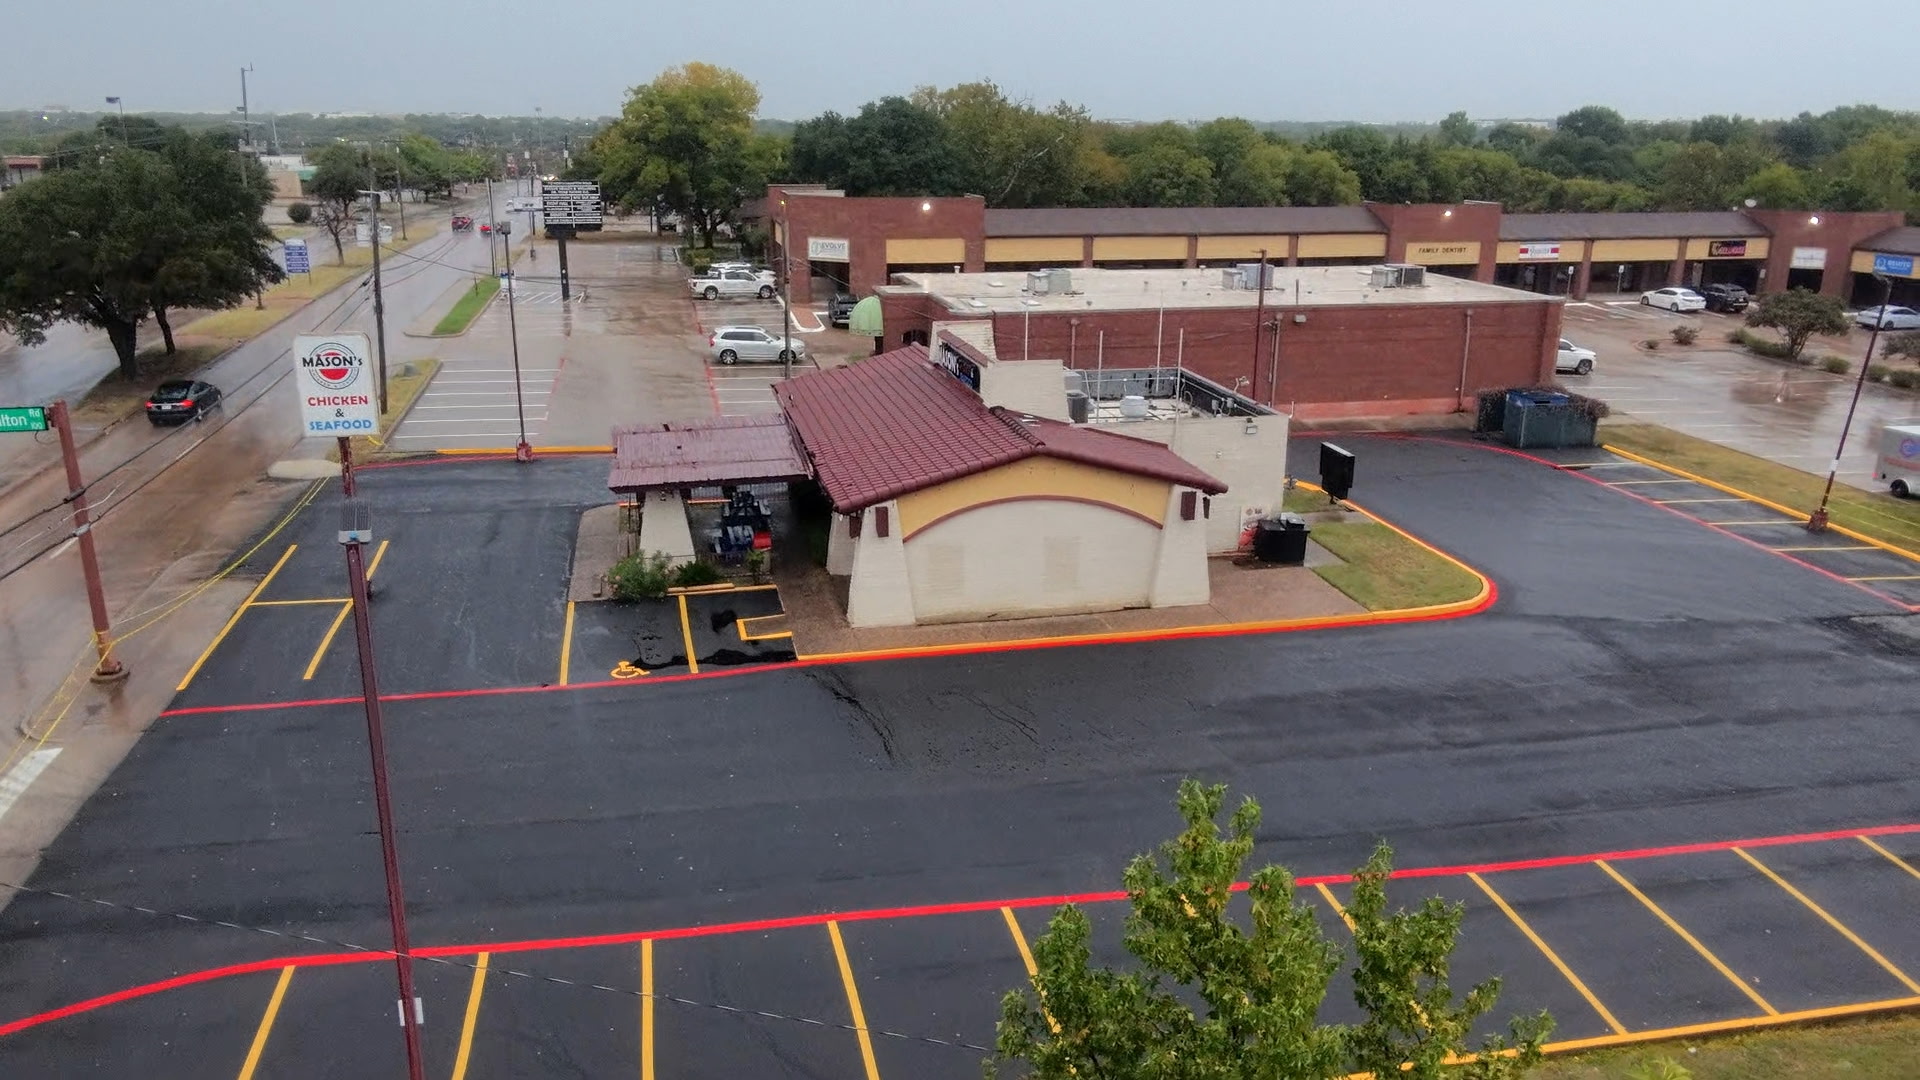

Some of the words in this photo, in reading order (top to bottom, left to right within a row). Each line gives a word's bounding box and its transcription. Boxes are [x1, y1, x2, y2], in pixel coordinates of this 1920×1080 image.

[308, 396, 368, 406] CHICKEN
[0, 414, 27, 426] lton
[29, 408, 40, 418] Rd
[335, 408, 345, 417] &
[309, 420, 372, 430] SEAFOOD
